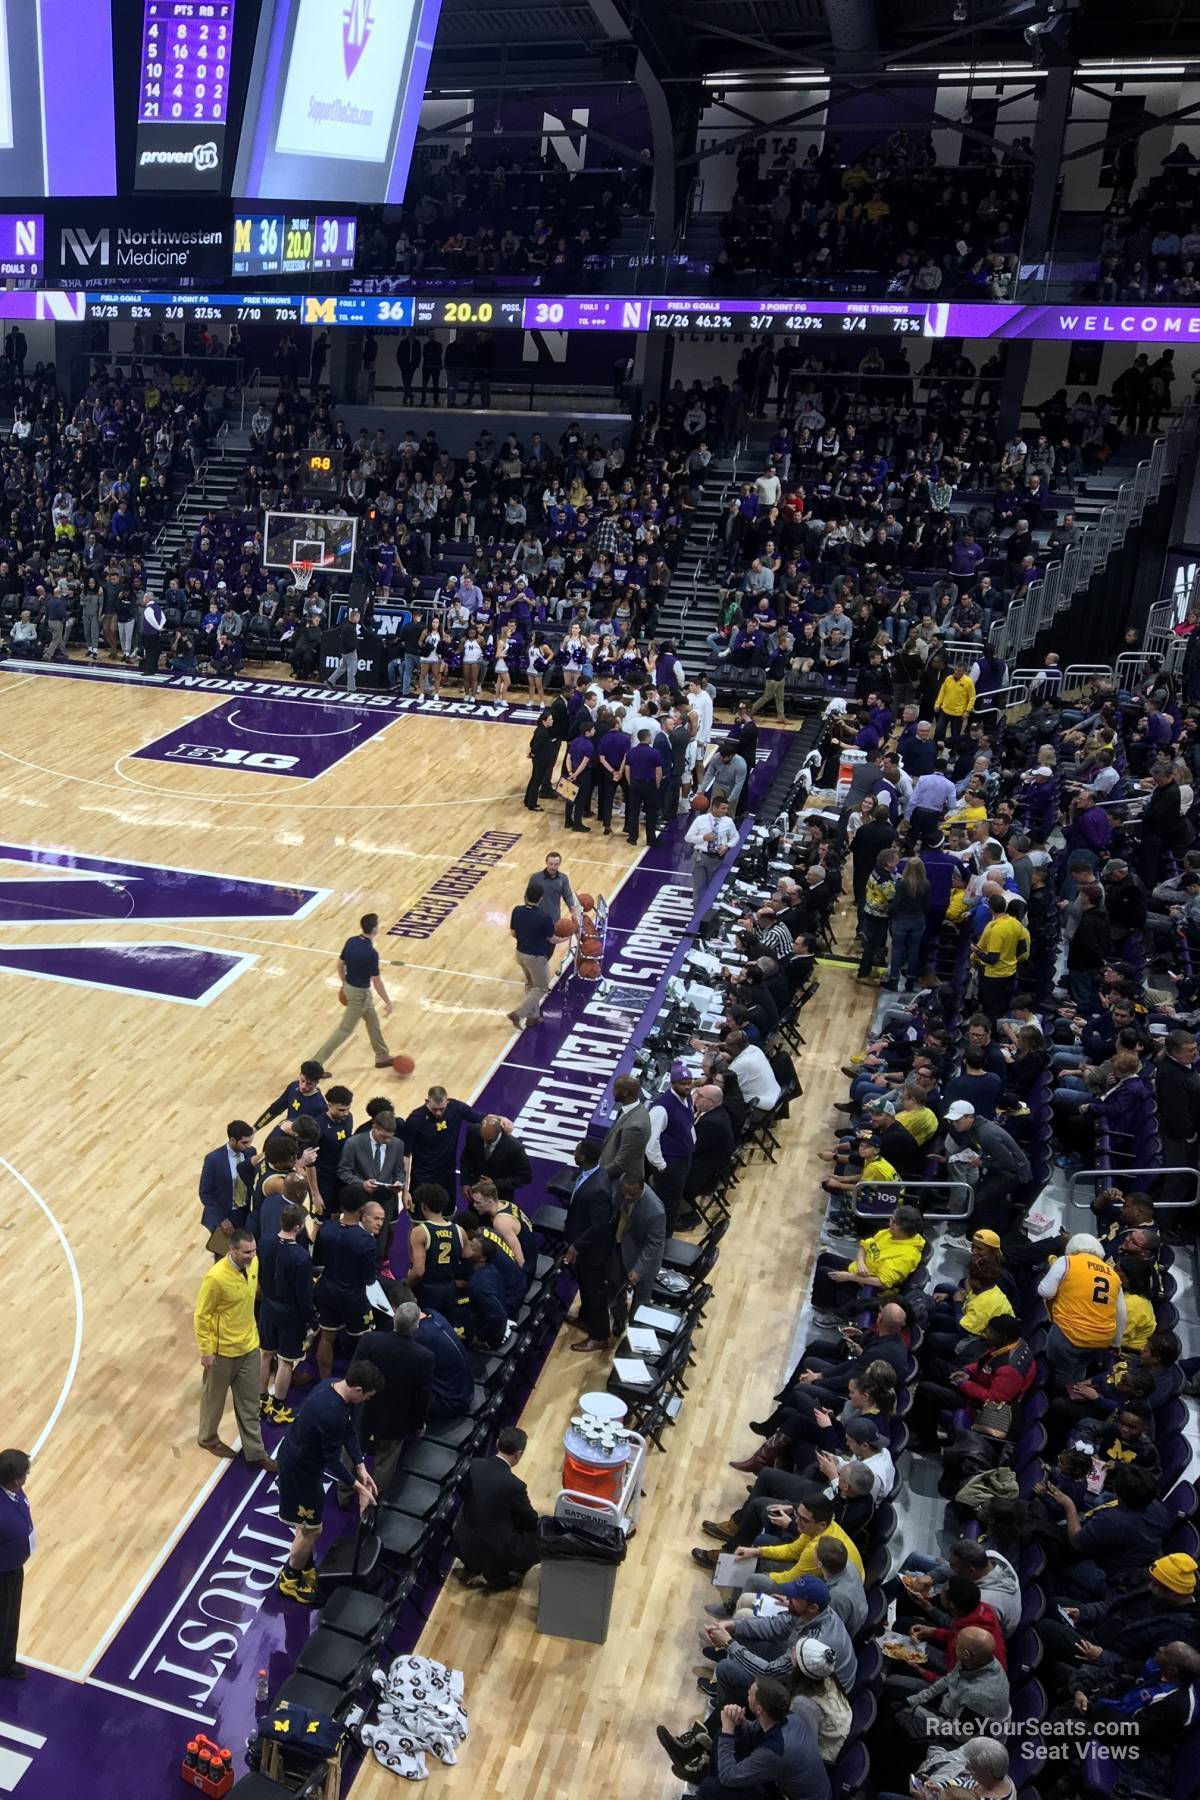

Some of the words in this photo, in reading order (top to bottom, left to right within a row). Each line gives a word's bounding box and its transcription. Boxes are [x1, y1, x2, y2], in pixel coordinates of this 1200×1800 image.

[174, 5, 193, 16] PTS
[221, 6, 228, 17] F
[148, 24, 159, 37] 4
[177, 24, 187, 39] 8
[200, 25, 209, 40] 2
[218, 26, 226, 40] 3
[148, 44, 157, 58] 5
[173, 44, 188, 58] 16
[198, 45, 208, 59] 4
[217, 45, 226, 60] 0
[146, 64, 162, 78] 10
[174, 64, 184, 78] 2
[197, 65, 206, 79] 0
[145, 83, 160, 97] 14
[173, 84, 182, 98] 4
[195, 84, 206, 98] 0
[214, 84, 222, 98] 2
[144, 103, 159, 116] 21
[172, 103, 182, 117] 0
[194, 104, 203, 117] 2
[15, 221, 36, 255] N
[117, 228, 222, 245] Northwestern
[234, 220, 251, 253] M
[259, 220, 278, 255] 36
[287, 232, 311, 258] 20.0
[322, 220, 338, 253] 30
[1, 264, 25, 274] FOULS
[31, 264, 38, 275] 0
[36, 290, 86, 320] N
[91, 306, 118, 318] 13/25
[131, 308, 151, 318] 52%
[166, 307, 184, 318] 3/8
[195, 307, 222, 319] 37.5%
[237, 308, 260, 320] 7/10
[276, 309, 298, 320] 70%
[305, 298, 337, 324] M
[377, 301, 404, 320] 36
[418, 302, 435, 311] HALF
[444, 303, 493, 322] 20.0
[535, 304, 564, 323] 30
[580, 303, 599, 311] FOULS
[622, 302, 642, 328] N
[668, 302, 688, 310] FIELD
[691, 302, 720, 311] GOALS
[847, 304, 868, 312] FREE
[871, 305, 909, 313] THROWS
[418, 312, 432, 321] 2ND
[654, 314, 689, 328] 12/26
[696, 314, 732, 328] 46.2%
[750, 316, 774, 329] 3/7
[786, 317, 822, 330] 42.9%
[842, 318, 866, 330] 3/4
[894, 318, 920, 331] 75%
[1059, 315, 1200, 334] WELCOME
[169, 675, 508, 718] NORTHWESTERN
[427, 830, 523, 900] WELSH-RYAN
[386, 896, 460, 940] ARENA
[609, 885, 694, 992] CHICAGO'S
[550, 1022, 636, 1076] TEN
[511, 1076, 608, 1168] TEAM
[877, 1192, 896, 1203] 109
[438, 1242, 452, 1264] 2
[1092, 1276, 1110, 1304] 2
